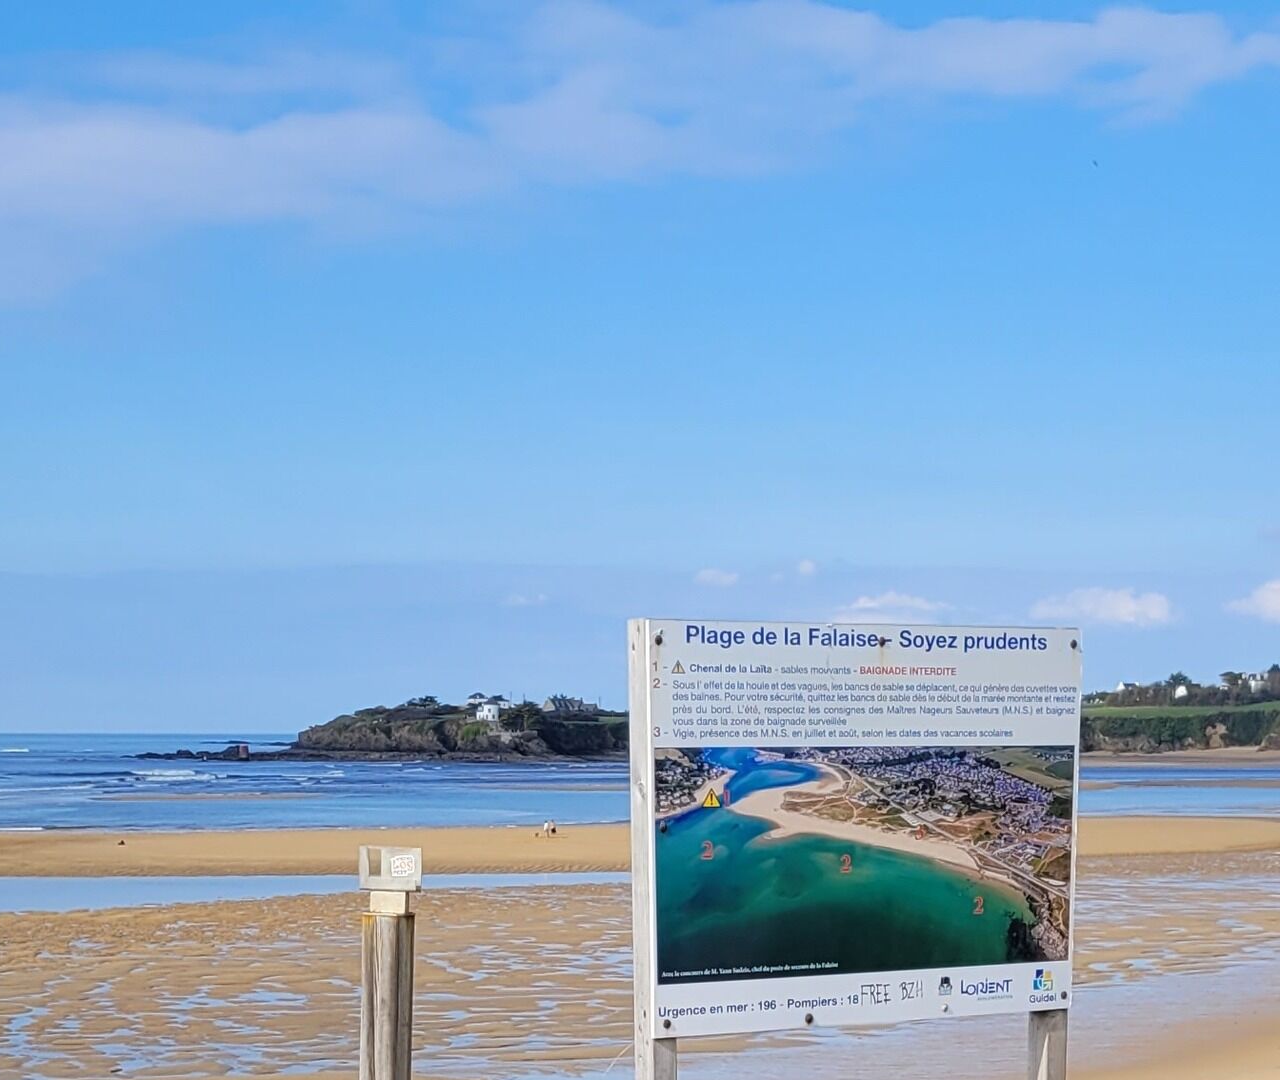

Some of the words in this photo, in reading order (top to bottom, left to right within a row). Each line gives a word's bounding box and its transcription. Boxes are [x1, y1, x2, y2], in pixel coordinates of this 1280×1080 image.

[686, 625, 746, 650] Plage
[752, 626, 778, 645] de
[784, 627, 801, 646] la
[808, 627, 878, 648] Falaise
[899, 629, 958, 652] Soyez
[964, 632, 1048, 653] prudents
[652, 661, 658, 672] 1
[689, 663, 722, 673] Chenal
[724, 664, 737, 673] de
[739, 664, 748, 673] la
[780, 665, 808, 674] sables
[810, 666, 851, 675] mouvants
[859, 666, 907, 675] BAIGNADE
[909, 667, 958, 676] INTERDITE
[653, 678, 661, 689] 2
[672, 680, 695, 690] Sous
[703, 680, 723, 690] effet
[724, 681, 736, 690] de
[737, 681, 745, 690] la
[746, 681, 770, 690] houle
[770, 682, 780, 690] et
[780, 682, 796, 690] des
[797, 684, 829, 692] vagues,
[831, 682, 843, 691] les
[844, 683, 869, 691] bancs
[870, 683, 881, 691] de
[882, 683, 904, 692] sable
[915, 683, 958, 693] déplacent,
[970, 684, 982, 693] qui
[1010, 685, 1025, 693] des
[1025, 685, 1058, 693] cuvettes
[672, 692, 689, 701] des
[724, 692, 746, 701] Pour
[747, 693, 768, 701] votre
[770, 693, 806, 702] sécurité,
[807, 693, 836, 703] quittez
[837, 694, 849, 702] les
[850, 693, 875, 702] bancs
[877, 694, 888, 702] de
[889, 694, 911, 702] sable
[928, 694, 936, 702] le
[937, 694, 961, 703] début
[961, 695, 972, 703] de
[973, 695, 980, 703] la
[981, 694, 1006, 703] marée
[1007, 695, 1043, 703] montante
[1044, 695, 1053, 703] et
[695, 705, 707, 714] du
[710, 705, 734, 714] bord.
[737, 704, 761, 714] L'été,
[764, 706, 806, 716] respectez
[808, 705, 821, 714] les
[823, 706, 866, 716] consignes
[868, 706, 884, 715] des
[919, 705, 953, 716] Nageurs
[955, 705, 999, 715] Sauveteurs
[1035, 706, 1044, 715] et
[1046, 706, 1076, 716] baignez
[696, 717, 718, 726] dans
[720, 717, 728, 726] la
[753, 717, 765, 726] de
[767, 717, 807, 727] baignade
[808, 716, 847, 726] surveillée
[653, 726, 661, 738] 3
[672, 729, 698, 740] Vigie,
[699, 729, 740, 740] présence
[742, 729, 758, 738] des
[804, 728, 826, 740] juillet
[827, 730, 837, 738] et
[838, 728, 860, 739] août,
[861, 729, 884, 738] selon
[886, 729, 897, 738] les
[898, 729, 921, 738] dates
[923, 729, 939, 738] des
[979, 729, 1014, 738] scolaires
[701, 841, 713, 861] 2
[840, 854, 852, 873] 2
[973, 897, 984, 915] 2
[861, 983, 891, 1006] FREE
[899, 979, 923, 1001] BZH
[1029, 993, 1057, 1003] Guidel
[658, 1006, 706, 1019] Urgence
[710, 1005, 723, 1014] en
[726, 1003, 748, 1013] mer
[758, 999, 777, 1011] 196
[787, 997, 838, 1009] Pompiers
[847, 994, 859, 1005] 18
